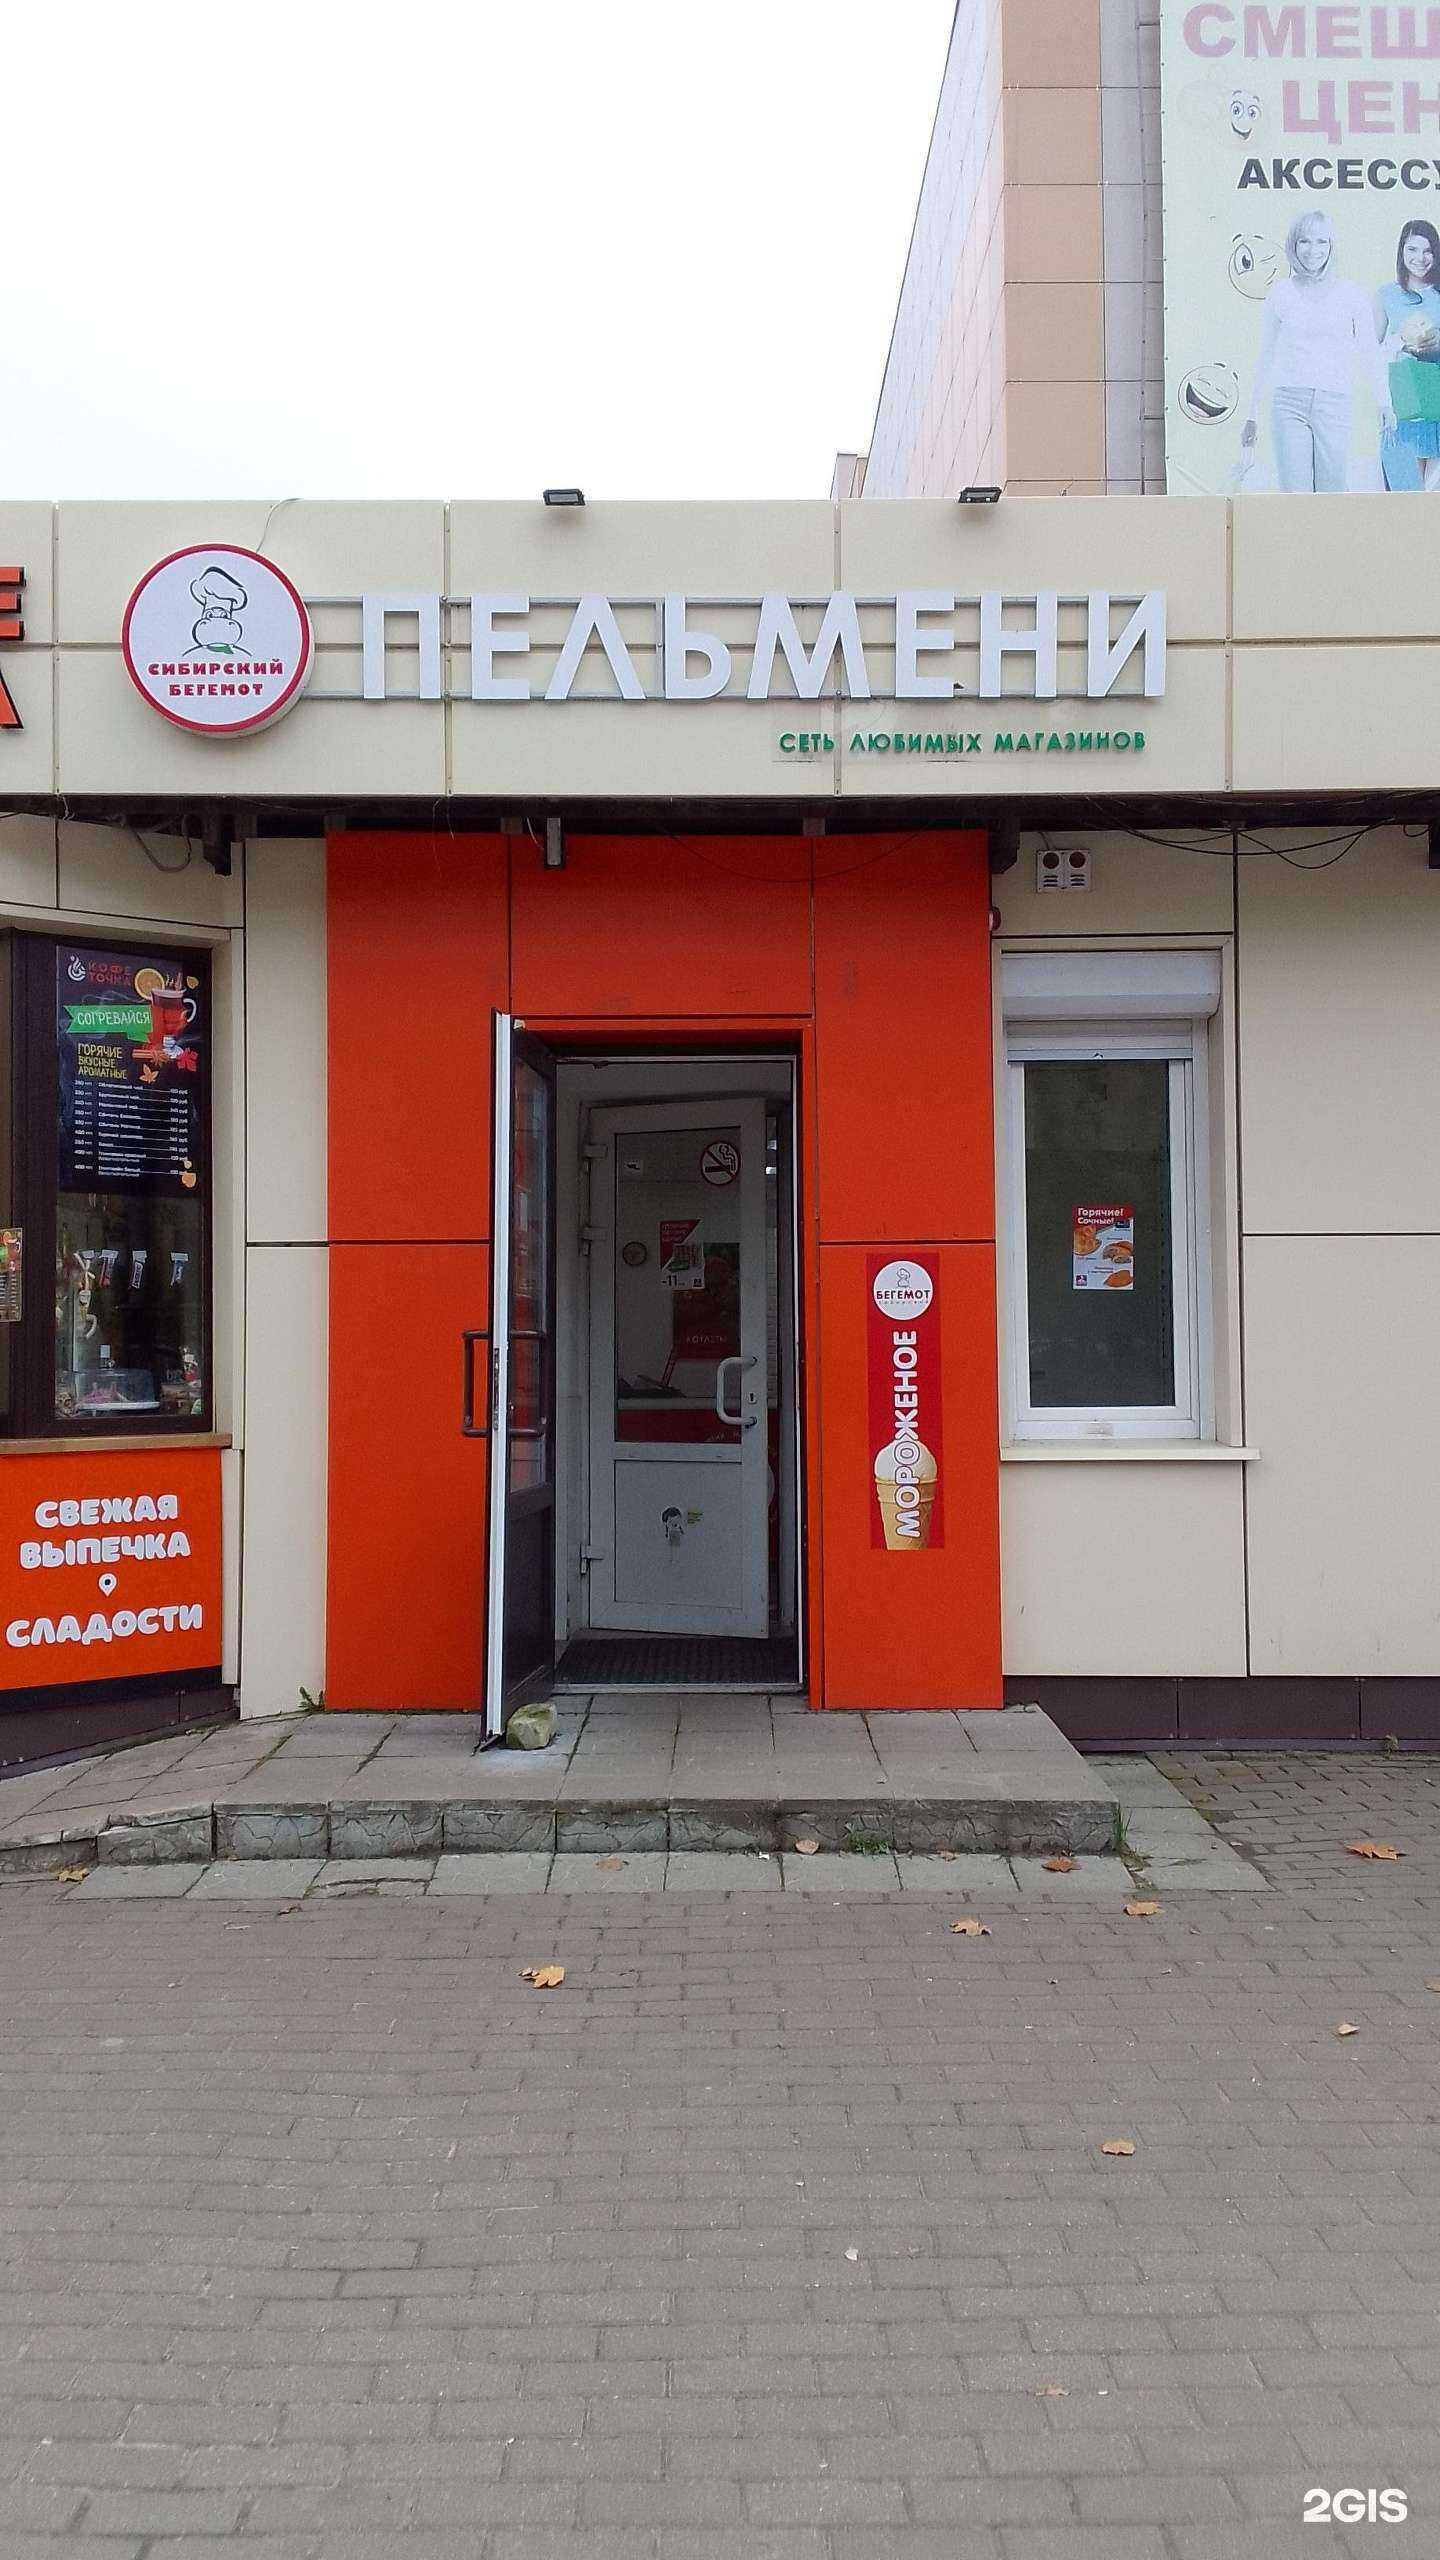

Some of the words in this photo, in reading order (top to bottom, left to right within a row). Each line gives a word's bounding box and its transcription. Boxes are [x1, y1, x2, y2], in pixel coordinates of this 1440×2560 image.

[362, 590, 1167, 700] ПЕЛЬМЕНИ
[148, 659, 283, 676] СИБИРСКИЙ
[169, 683, 264, 696] БЕГЕМОТ
[779, 733, 836, 753] СЕТЬ
[849, 733, 983, 753] ЛЮБИМЫХ
[994, 731, 1147, 752] МАГАЗИНОВ
[77, 1009, 152, 1026] СОГРЕВАЙСЯ
[77, 1043, 123, 1059] ГОРЯЧИЕ
[77, 1056, 116, 1068] ВКУСНЫЕ
[77, 1066, 128, 1080] АРОМАТНЫЕ
[1077, 1207, 1124, 1217] Горячие!
[1077, 1217, 1115, 1225] Сочные!
[876, 1290, 931, 1300] БЕГЕМОТ
[892, 1330, 921, 1538] МОРОЖЕНОЕ
[35, 1494, 179, 1529] СВЕЖАЯ
[19, 1531, 192, 1570] ВЫПЕЧКА
[5, 1603, 204, 1648] СЛАДОСТИ
